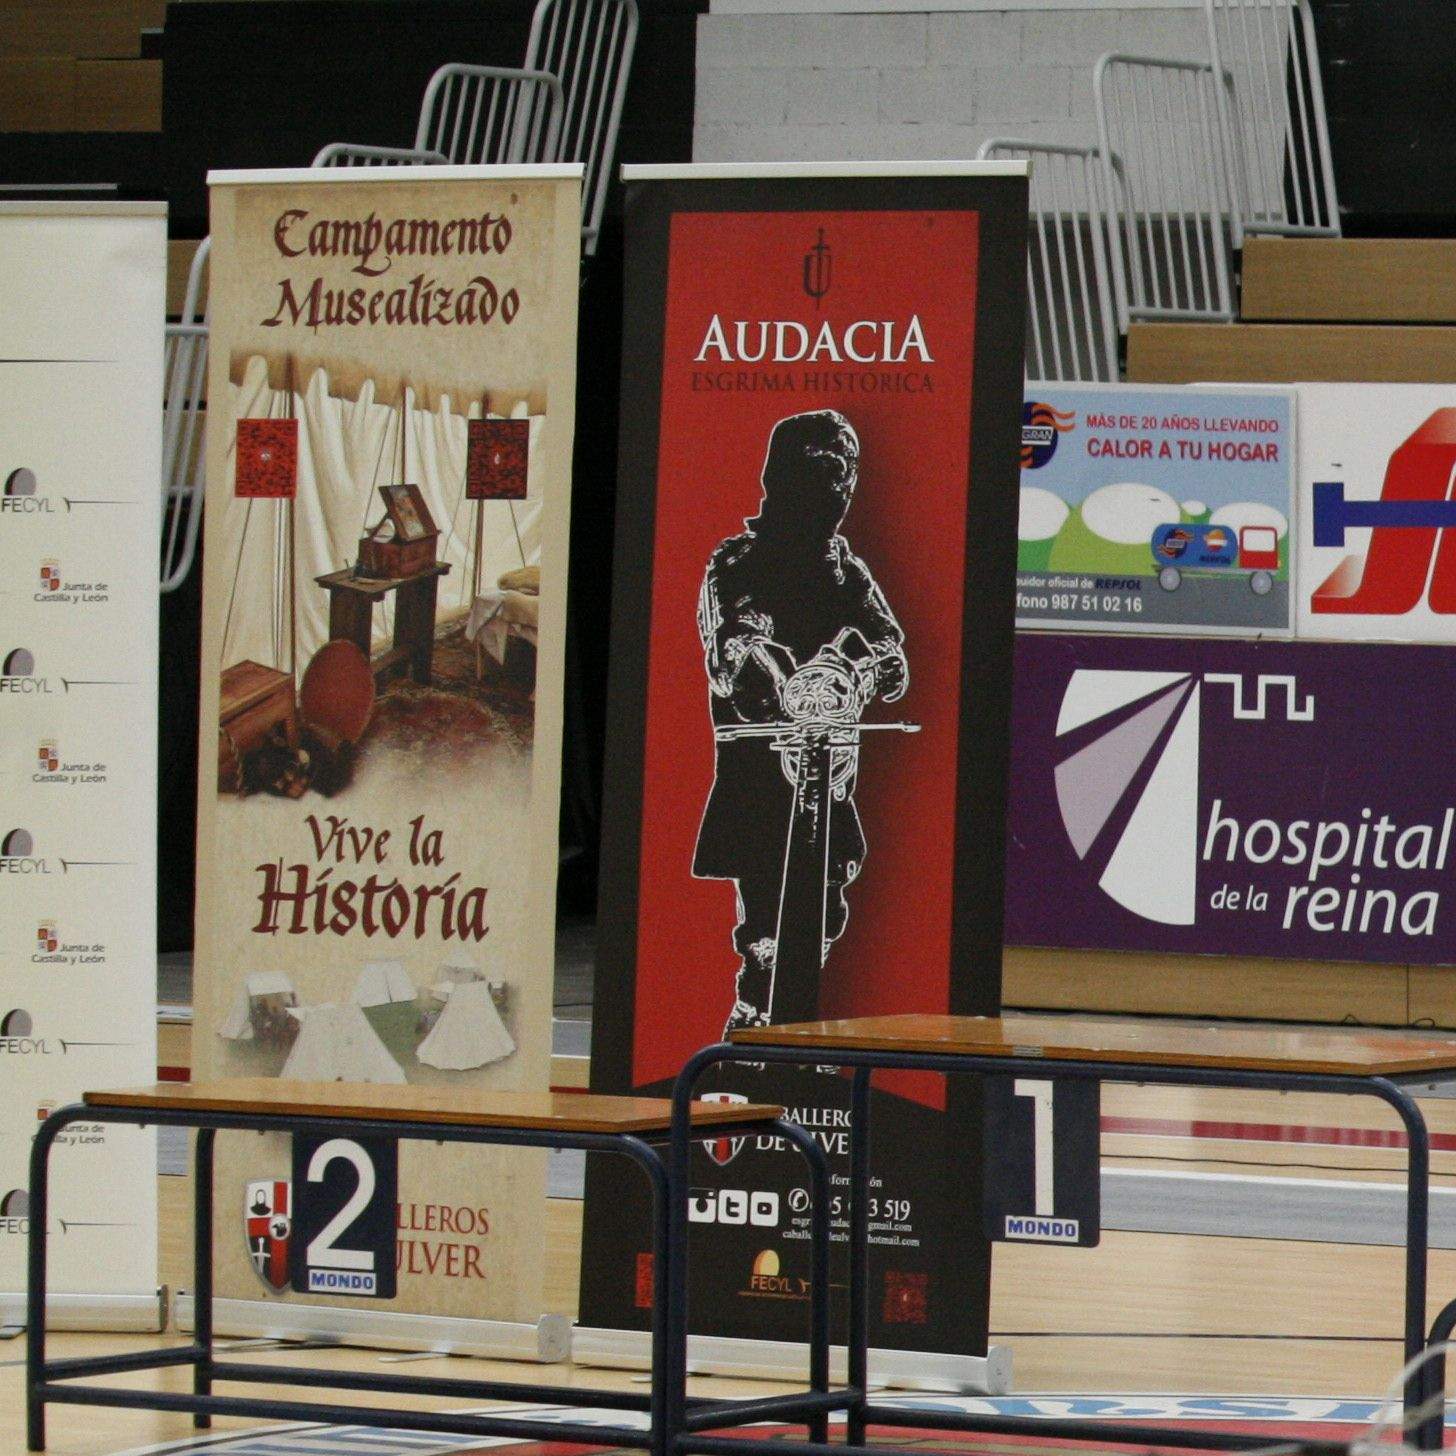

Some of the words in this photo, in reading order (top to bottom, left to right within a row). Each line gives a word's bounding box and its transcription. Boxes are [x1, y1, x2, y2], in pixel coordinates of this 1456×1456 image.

[273, 209, 512, 277] Campamento
[260, 273, 520, 335] Musealizado
[693, 313, 934, 363] AUDACIA
[691, 372, 795, 392] ESGRIMA
[1119, 416, 1137, 429] DE
[1142, 417, 1157, 430] 20
[1161, 413, 1200, 430] AÑOS
[1203, 417, 1279, 433] LLEVANDO
[1087, 437, 1153, 459] CALOR
[1158, 440, 1172, 459] A
[1177, 441, 1202, 460] TU
[1208, 441, 1279, 462] HOGAR
[1, 497, 56, 513] FECYL
[1080, 578, 1094, 590] de
[1051, 594, 1078, 610] 987
[1081, 595, 1099, 611] 51
[1103, 596, 1121, 612] 02
[1126, 597, 1143, 613] 16
[0, 678, 52, 693] FECYL
[304, 814, 388, 866] Vive
[408, 814, 445, 867] la
[1202, 799, 1455, 881] hospital
[0, 858, 51, 874] FECYL
[250, 857, 490, 943] Historia
[1210, 884, 1240, 911] de
[1245, 884, 1268, 912] la
[1282, 873, 1440, 936] reina
[1013, 1079, 1055, 1216] 1
[306, 1139, 377, 1270] 2
[1007, 1218, 1078, 1239] MONDO
[311, 1272, 374, 1292] MONDO
[751, 1275, 792, 1293] FECYL
